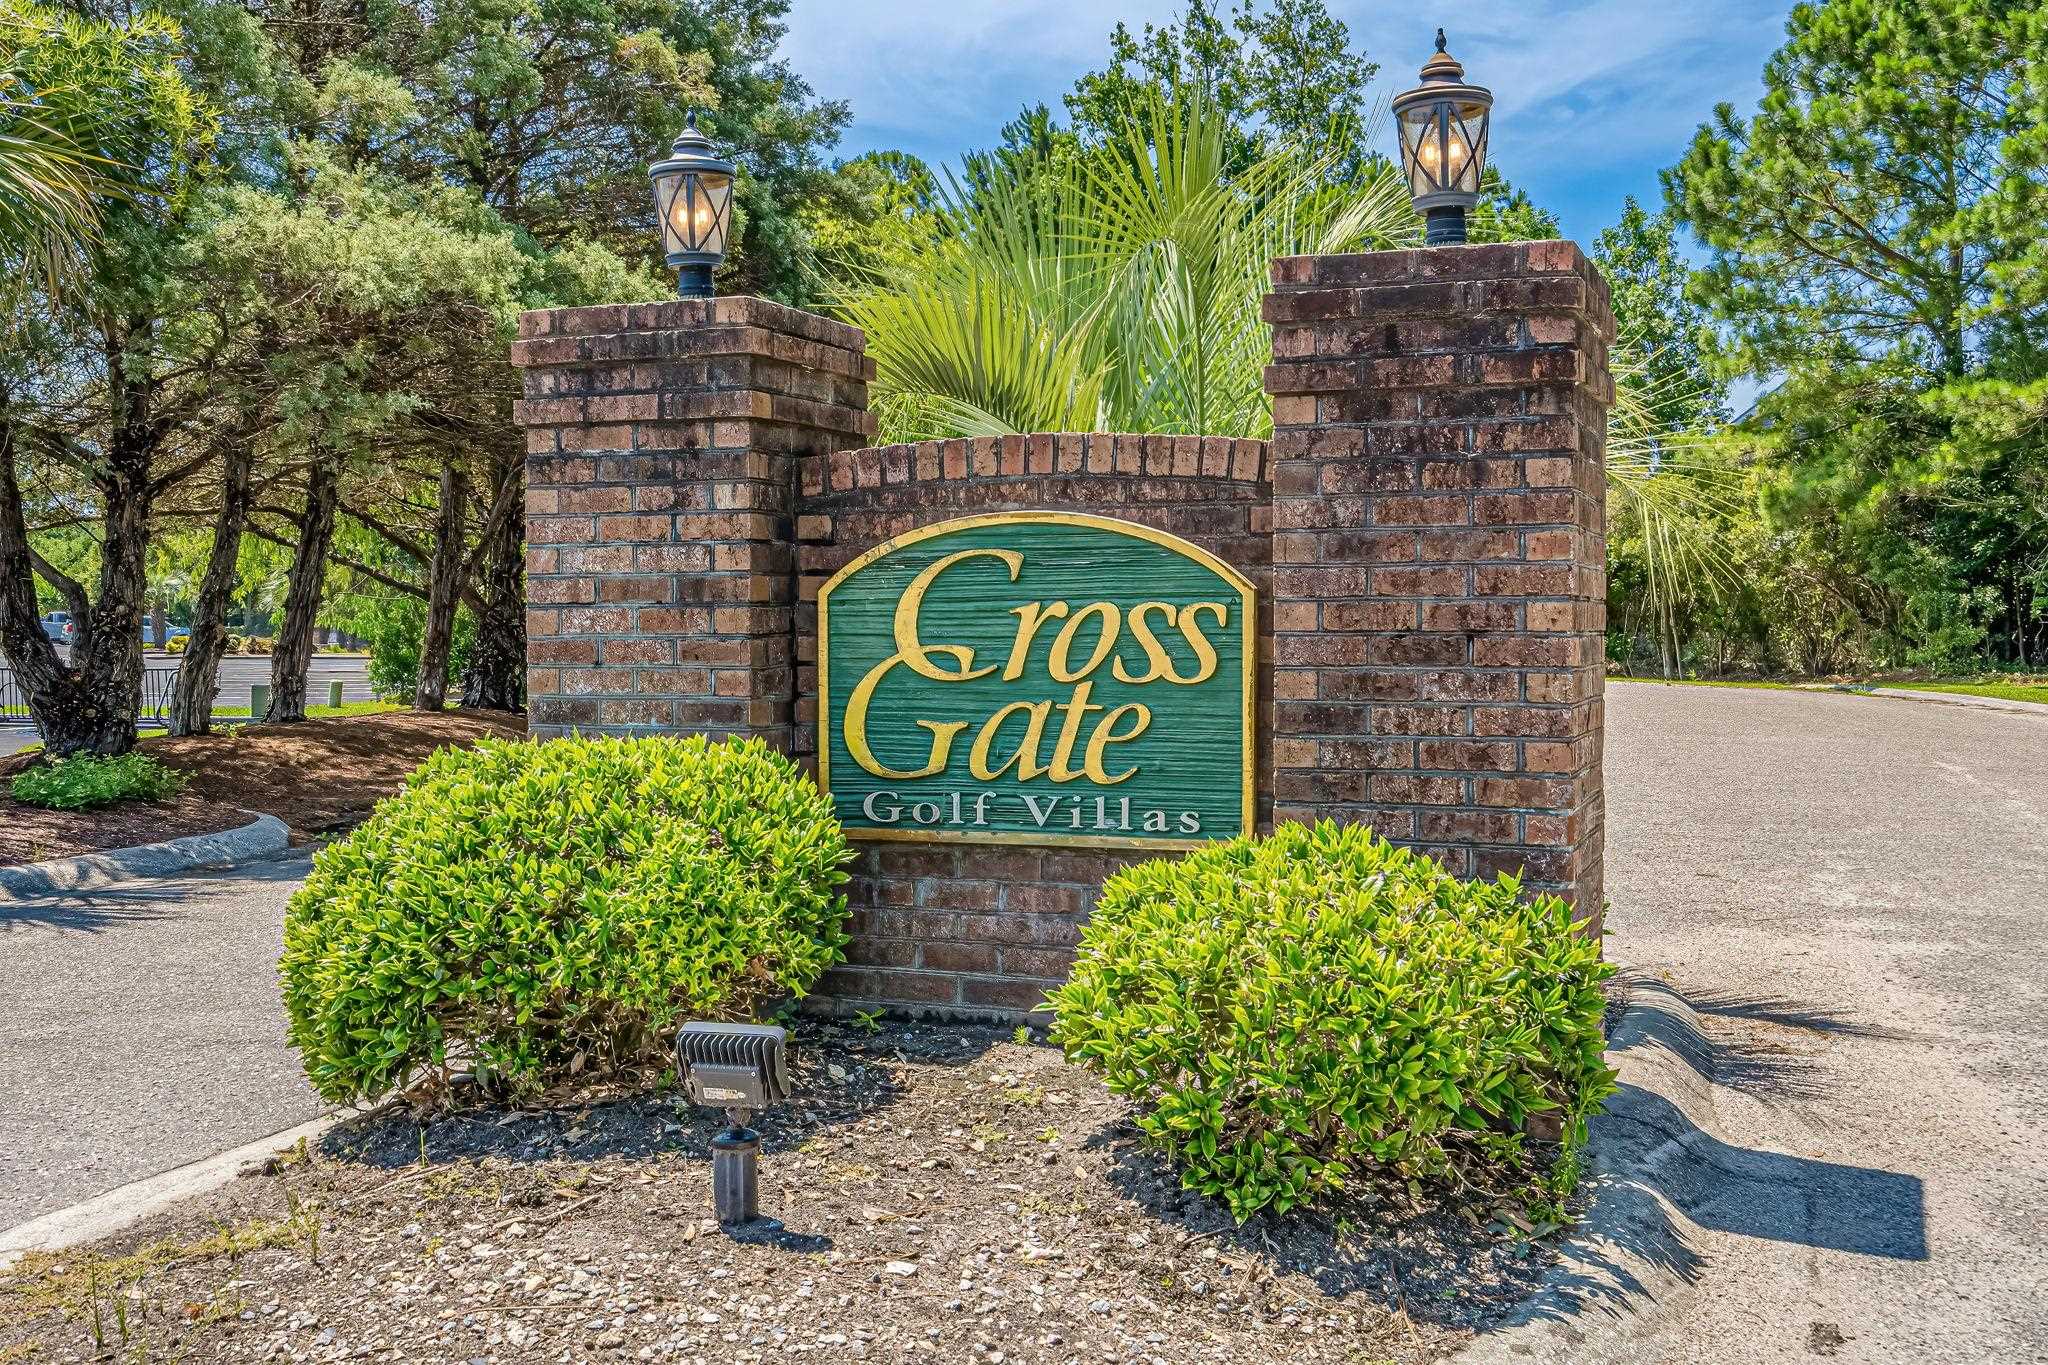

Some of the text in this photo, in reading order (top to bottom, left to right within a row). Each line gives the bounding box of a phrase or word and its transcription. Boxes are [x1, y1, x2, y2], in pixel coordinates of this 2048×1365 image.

[893, 548, 1228, 685] Cross
[843, 652, 1152, 785] Gate
[862, 790, 1201, 834] Golf Villas
